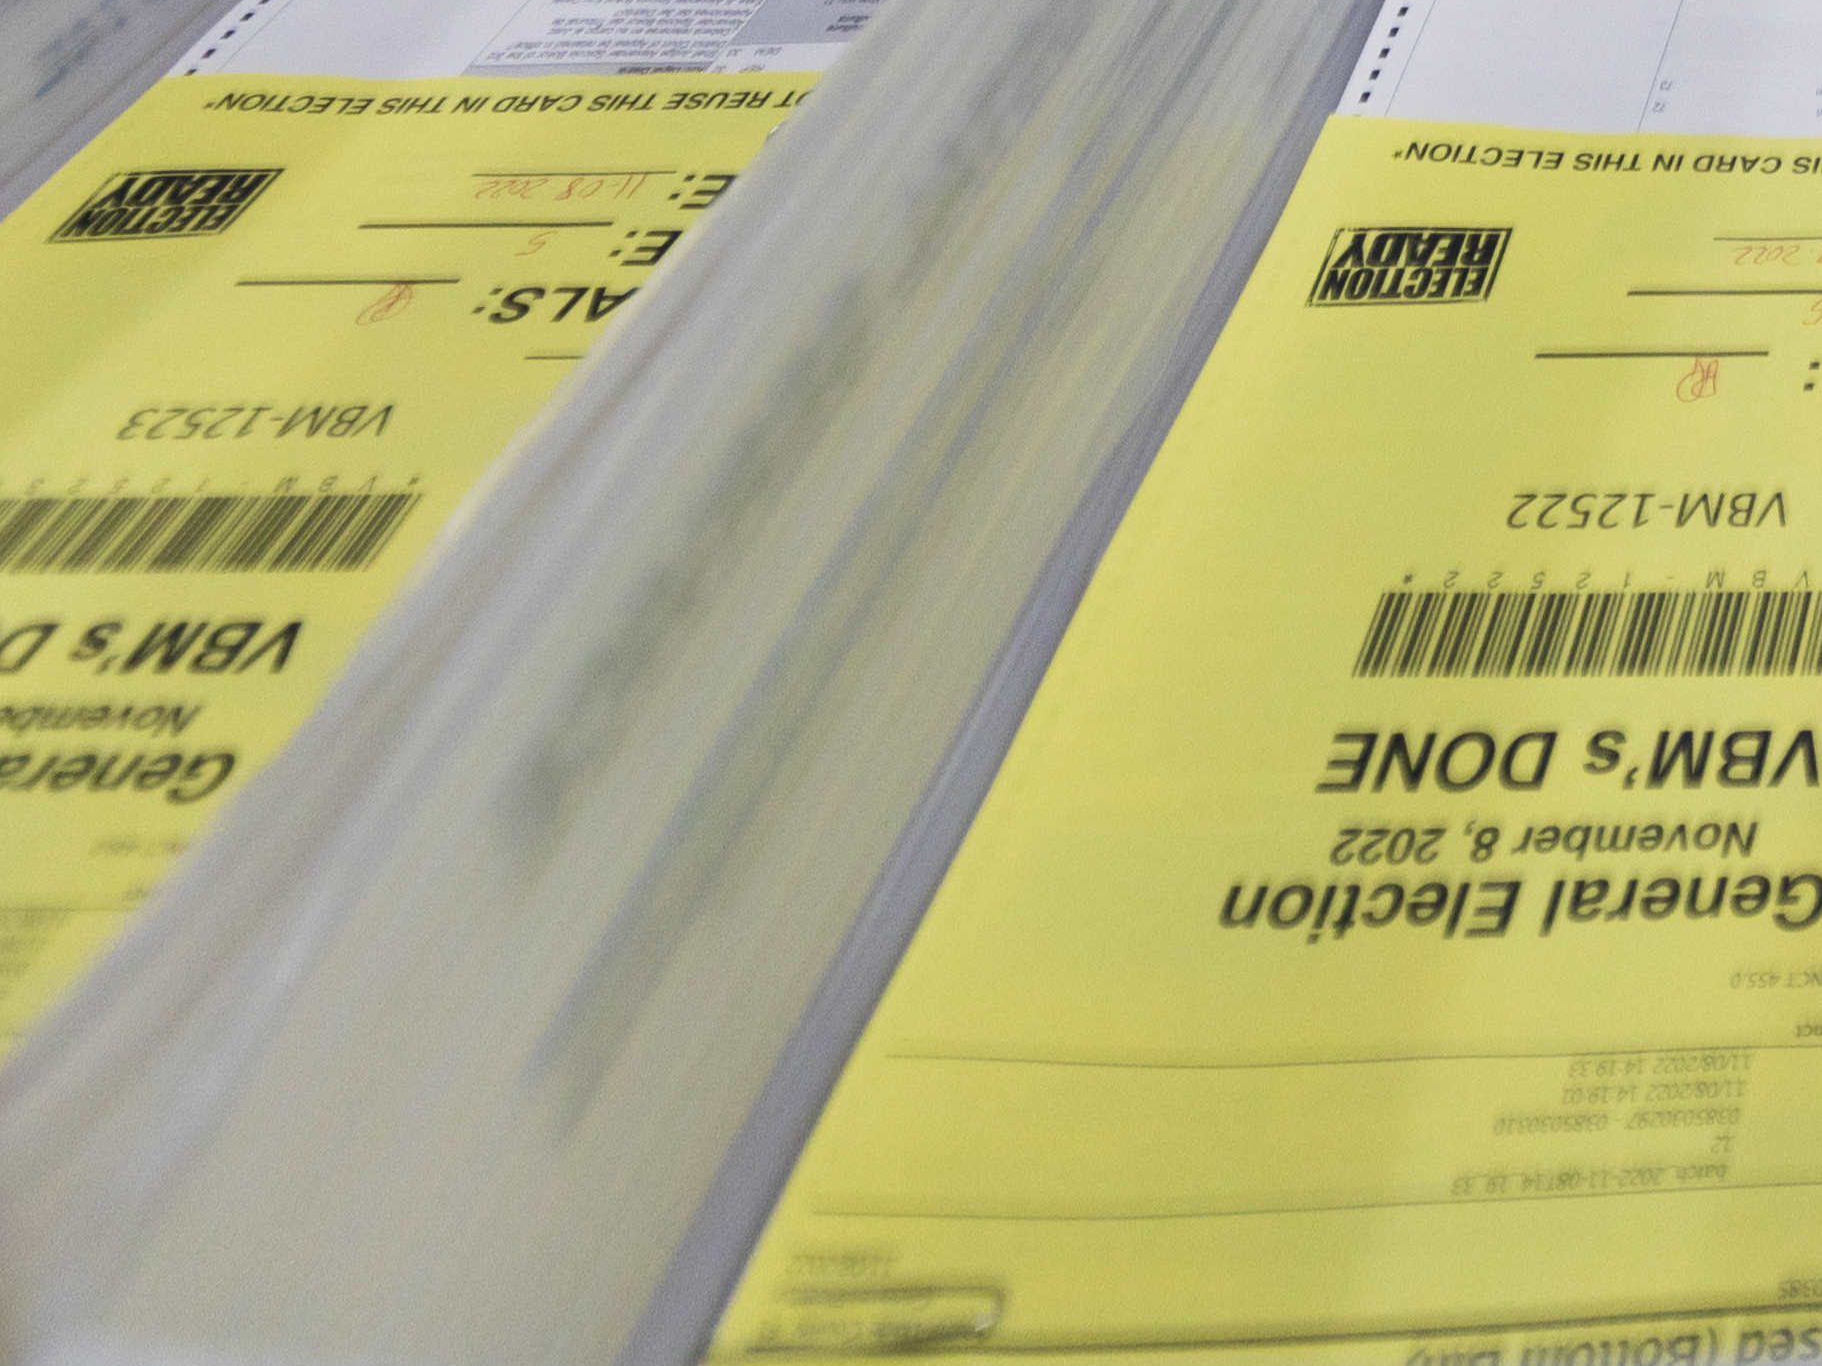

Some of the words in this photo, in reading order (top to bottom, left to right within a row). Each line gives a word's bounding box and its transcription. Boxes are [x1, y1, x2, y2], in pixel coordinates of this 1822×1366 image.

[374, 92, 446, 116] THIS
[448, 91, 485, 115] IN
[488, 91, 580, 115] CARD
[587, 91, 657, 115] THIS
[664, 90, 771, 115] REUSE
[1571, 149, 1644, 174] THIS
[1653, 152, 1689, 174] IN
[1698, 153, 1785, 177] CARD
[90, 173, 268, 208] READY
[56, 201, 240, 239] ELECTION
[1336, 230, 1501, 269] READY
[1315, 266, 1491, 301] ELECTION
[115, 403, 397, 442] VBM-12523
[1505, 490, 1790, 530] VBM-12522
[67, 619, 304, 675] VBM's
[0, 748, 238, 807] Genera
[1313, 727, 1559, 794] DONE
[1581, 727, 1822, 790] VBM's
[1328, 825, 1448, 868] 2022
[1461, 819, 1502, 865] 8,
[1511, 819, 1760, 862] November
[1217, 877, 1523, 945] Election
